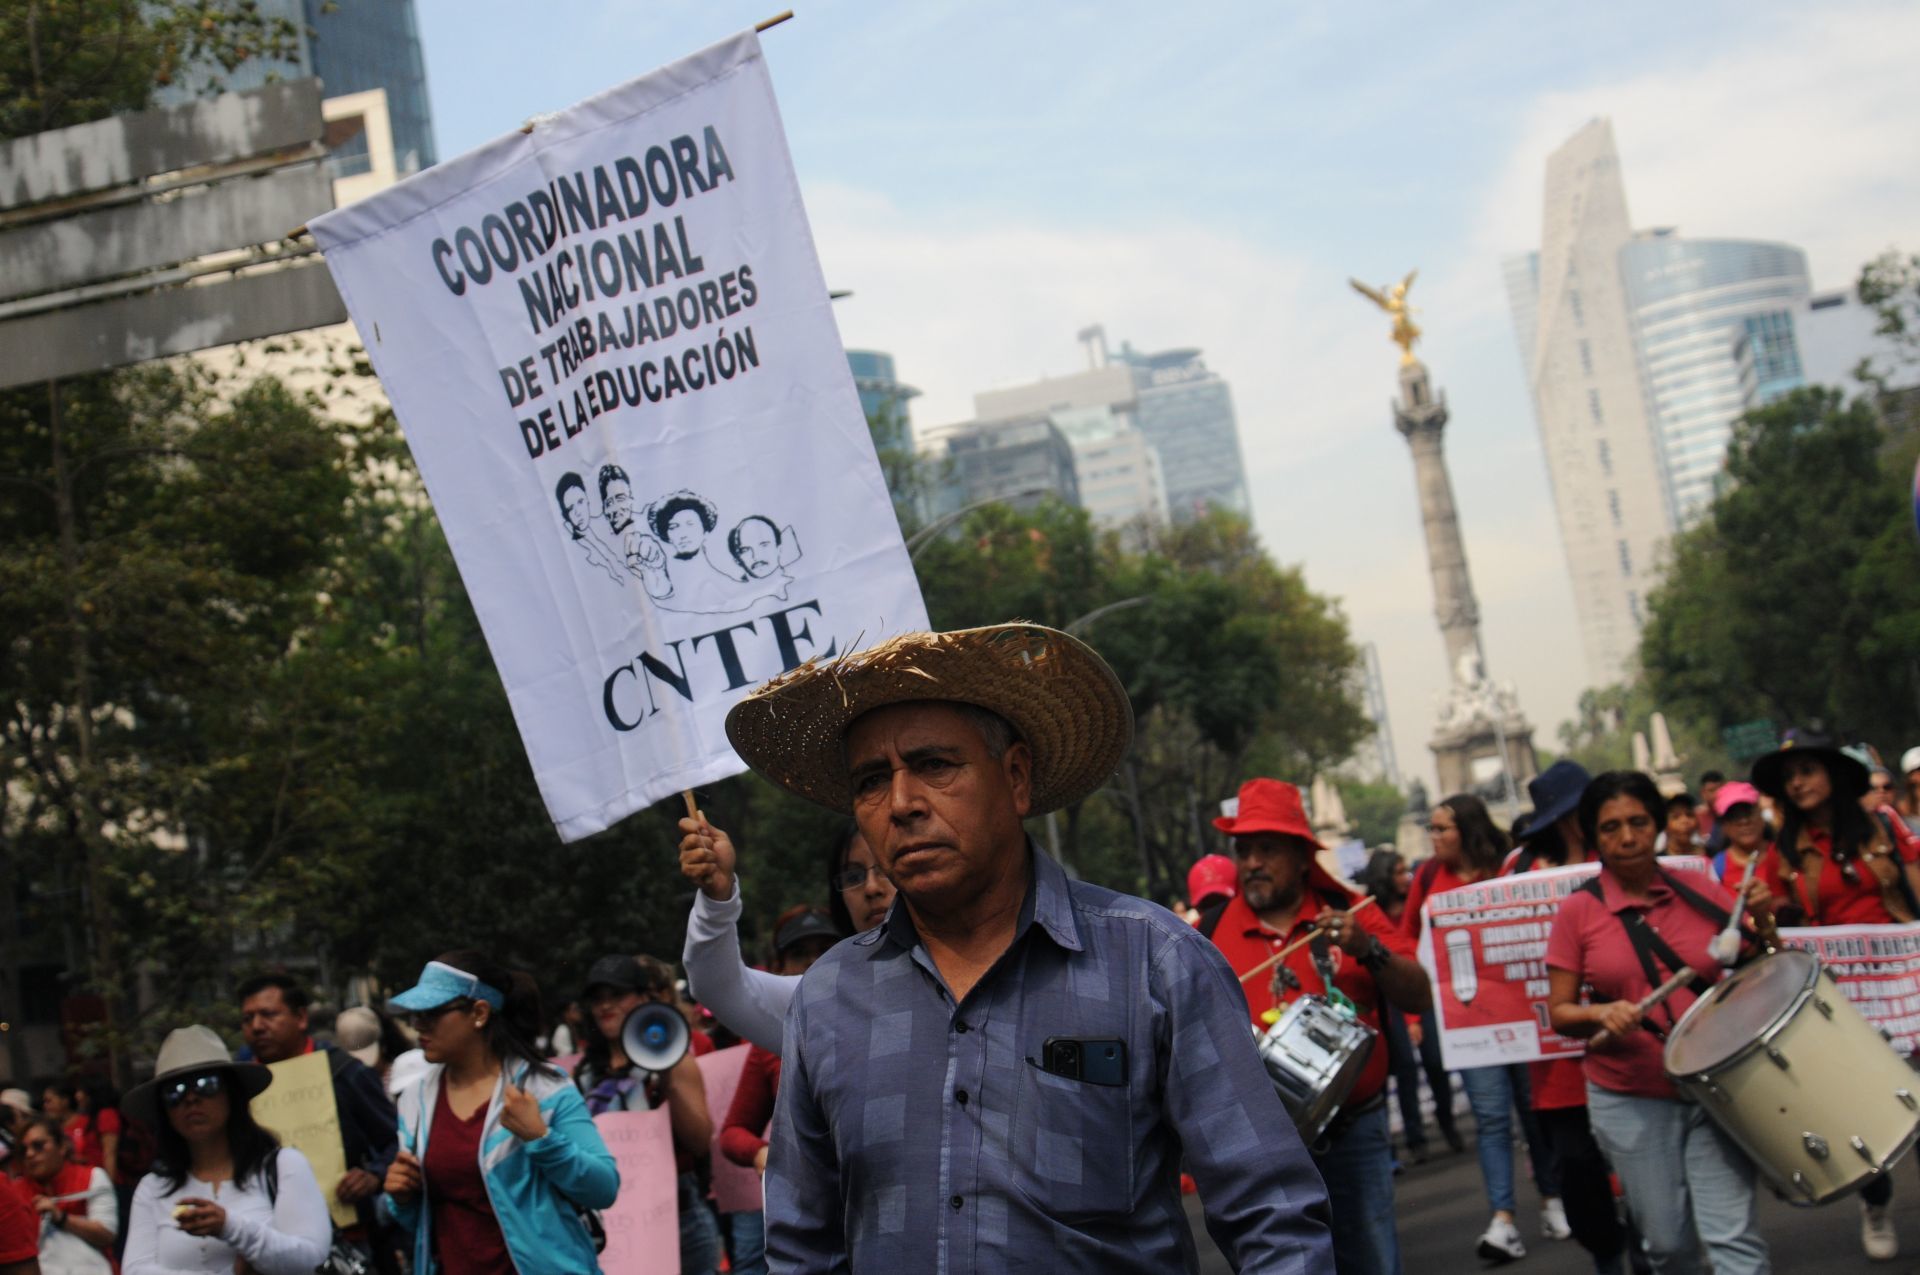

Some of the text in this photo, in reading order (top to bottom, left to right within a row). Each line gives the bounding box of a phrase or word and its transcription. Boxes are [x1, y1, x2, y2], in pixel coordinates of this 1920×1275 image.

[432, 125, 735, 296] COORDINADORA
[517, 215, 704, 335] NACIONAL
[499, 264, 758, 409] DE TRABAJADORES
[519, 326, 760, 460] DE LA EDUCACIÓN
[603, 599, 837, 732] CNTE
